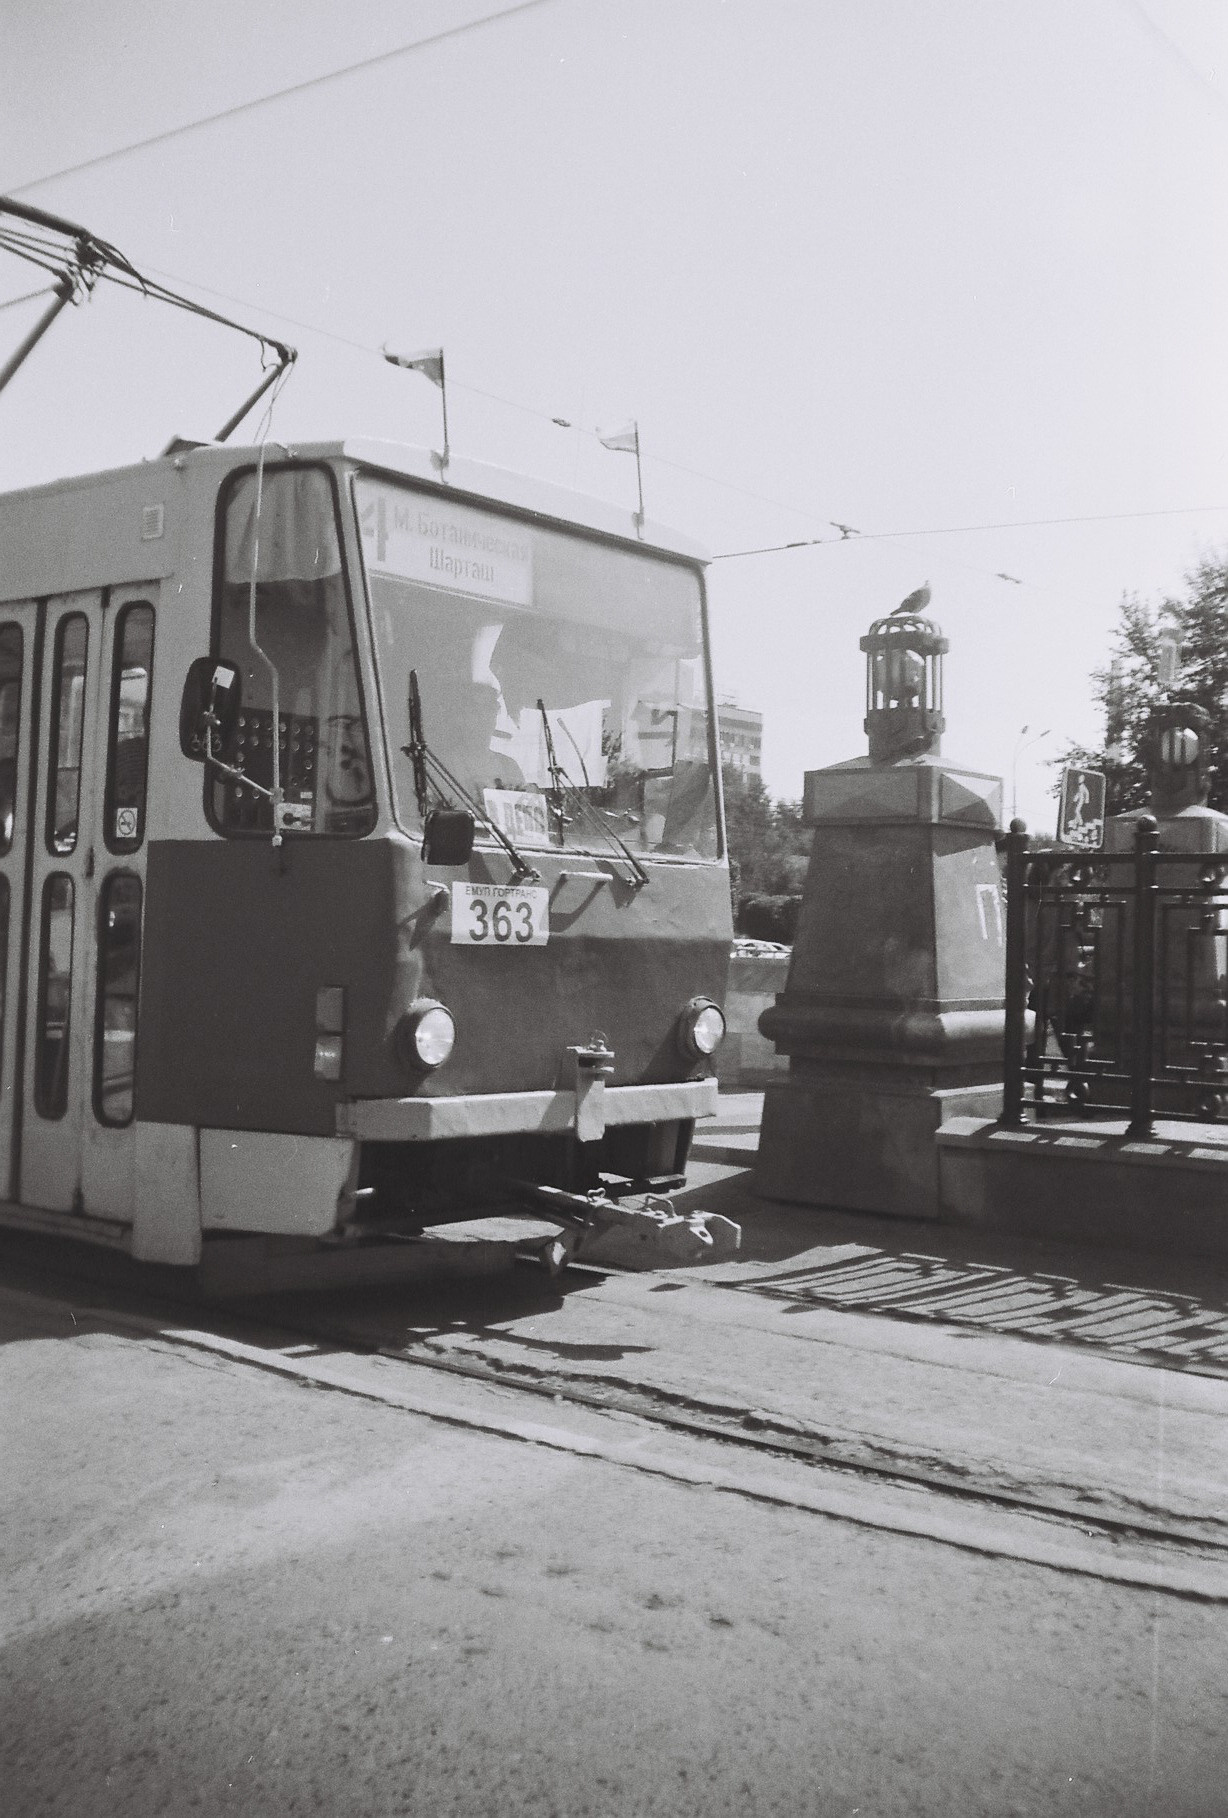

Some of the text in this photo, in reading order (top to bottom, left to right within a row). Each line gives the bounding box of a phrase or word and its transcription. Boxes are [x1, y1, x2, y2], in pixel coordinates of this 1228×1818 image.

[360, 497, 389, 562] 4
[429, 546, 494, 582] Шарташ
[465, 885, 537, 899] ЕМУП ГОРТРАНС
[469, 899, 533, 943] 363
